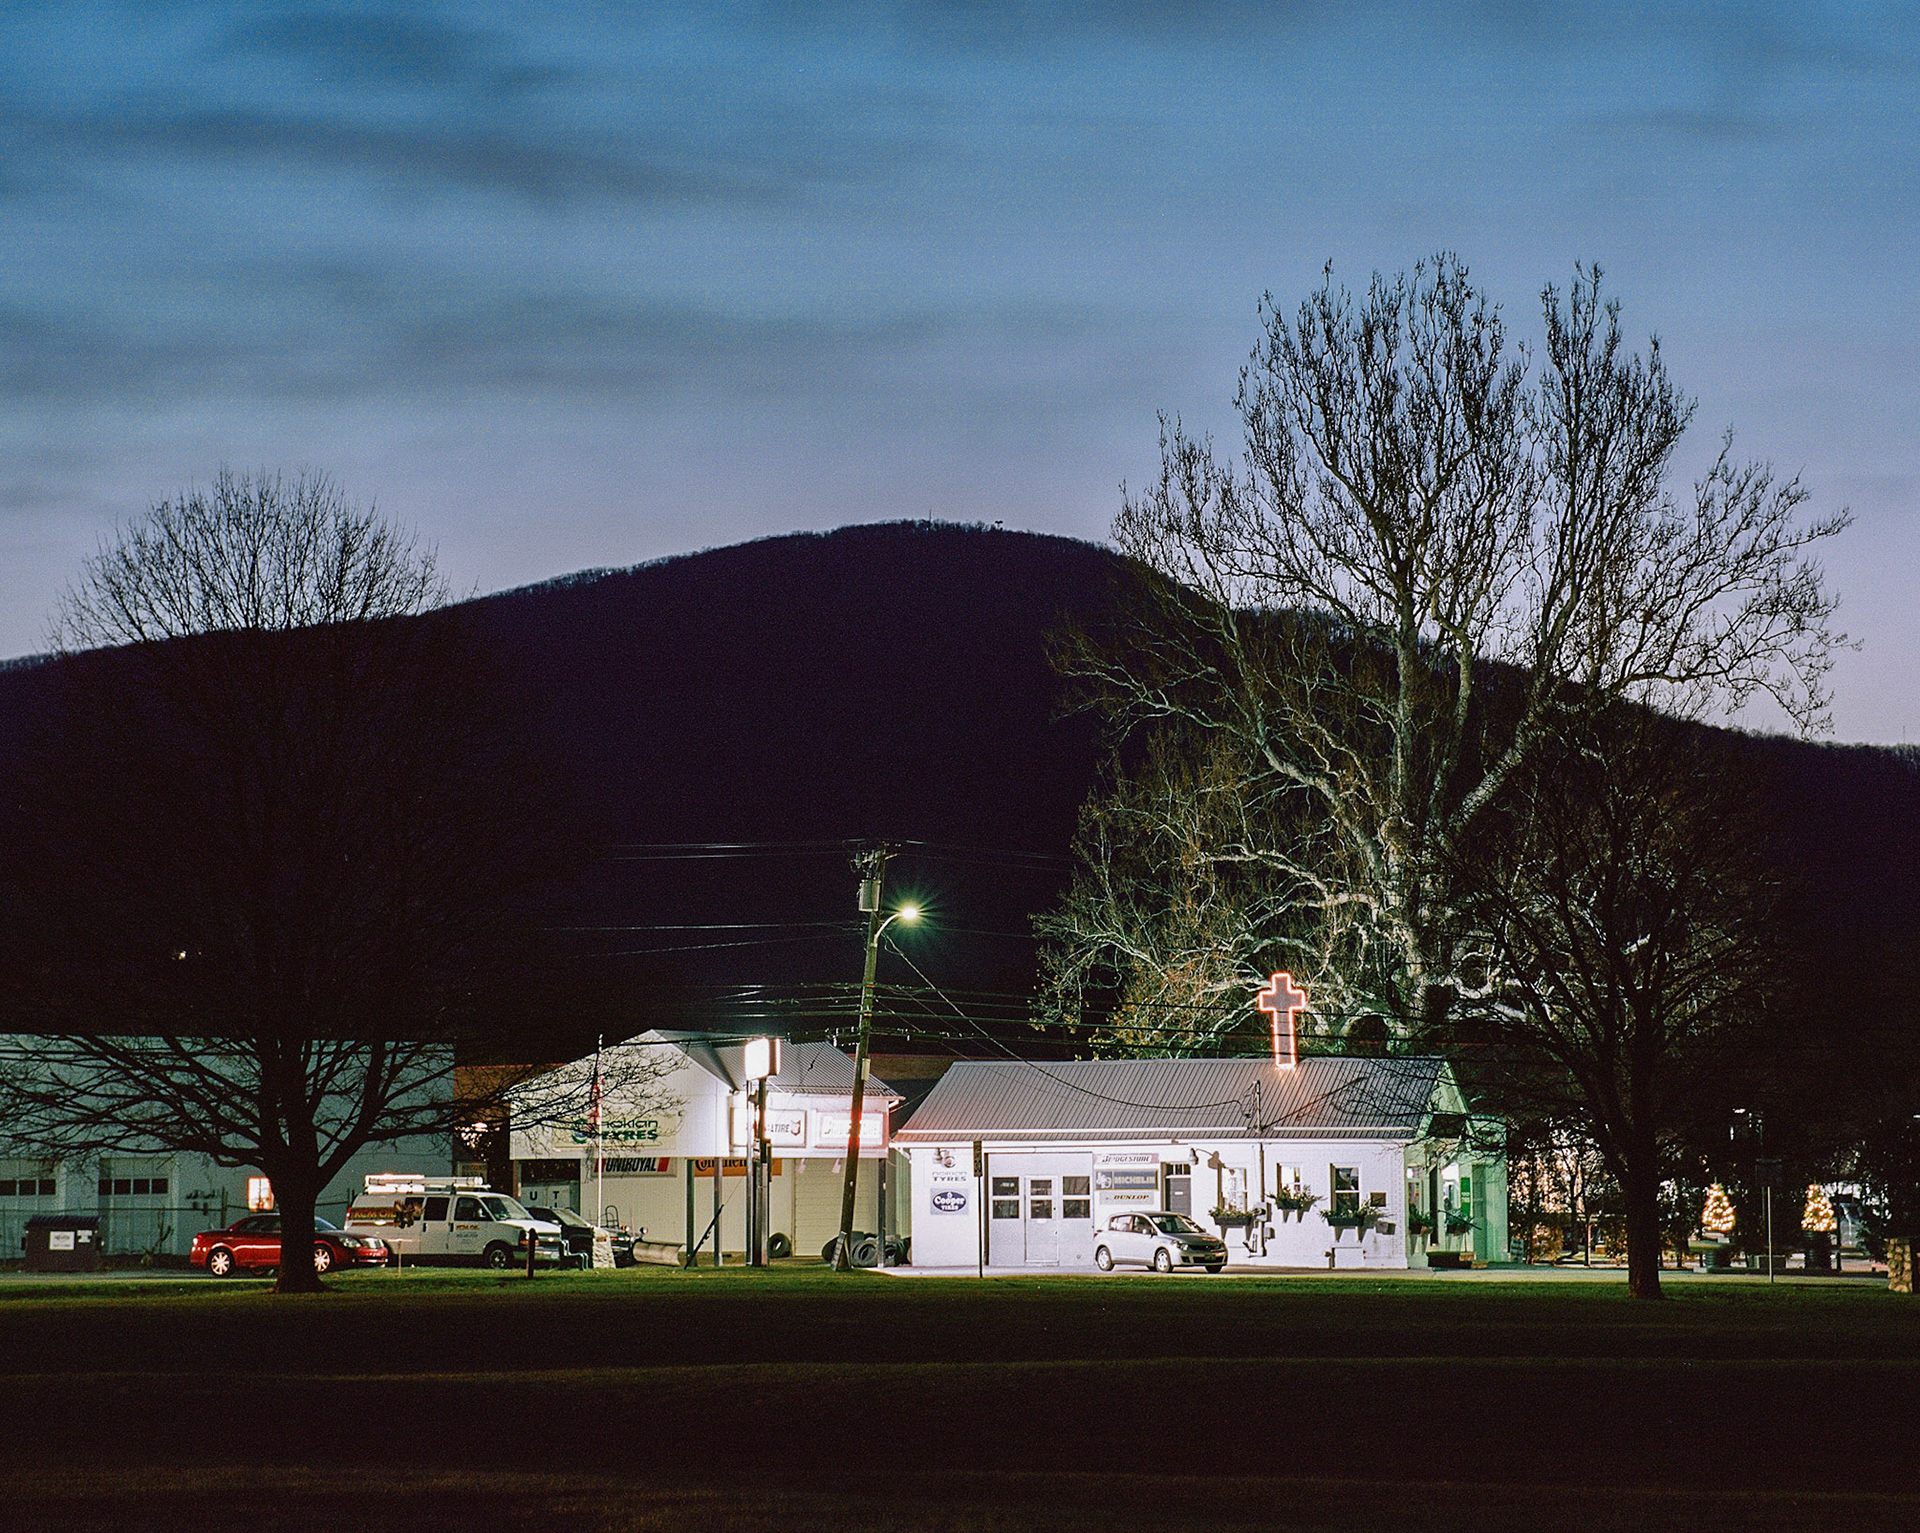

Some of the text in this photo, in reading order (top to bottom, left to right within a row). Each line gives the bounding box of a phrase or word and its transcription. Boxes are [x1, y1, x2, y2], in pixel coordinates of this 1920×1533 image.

[601, 1129, 659, 1140] TYRES
[606, 1157, 657, 1172] UNIROYAL
[1114, 1176, 1156, 1184] MICHELIN
[934, 1195, 965, 1206] Cooper
[379, 1209, 397, 1218] OIL
